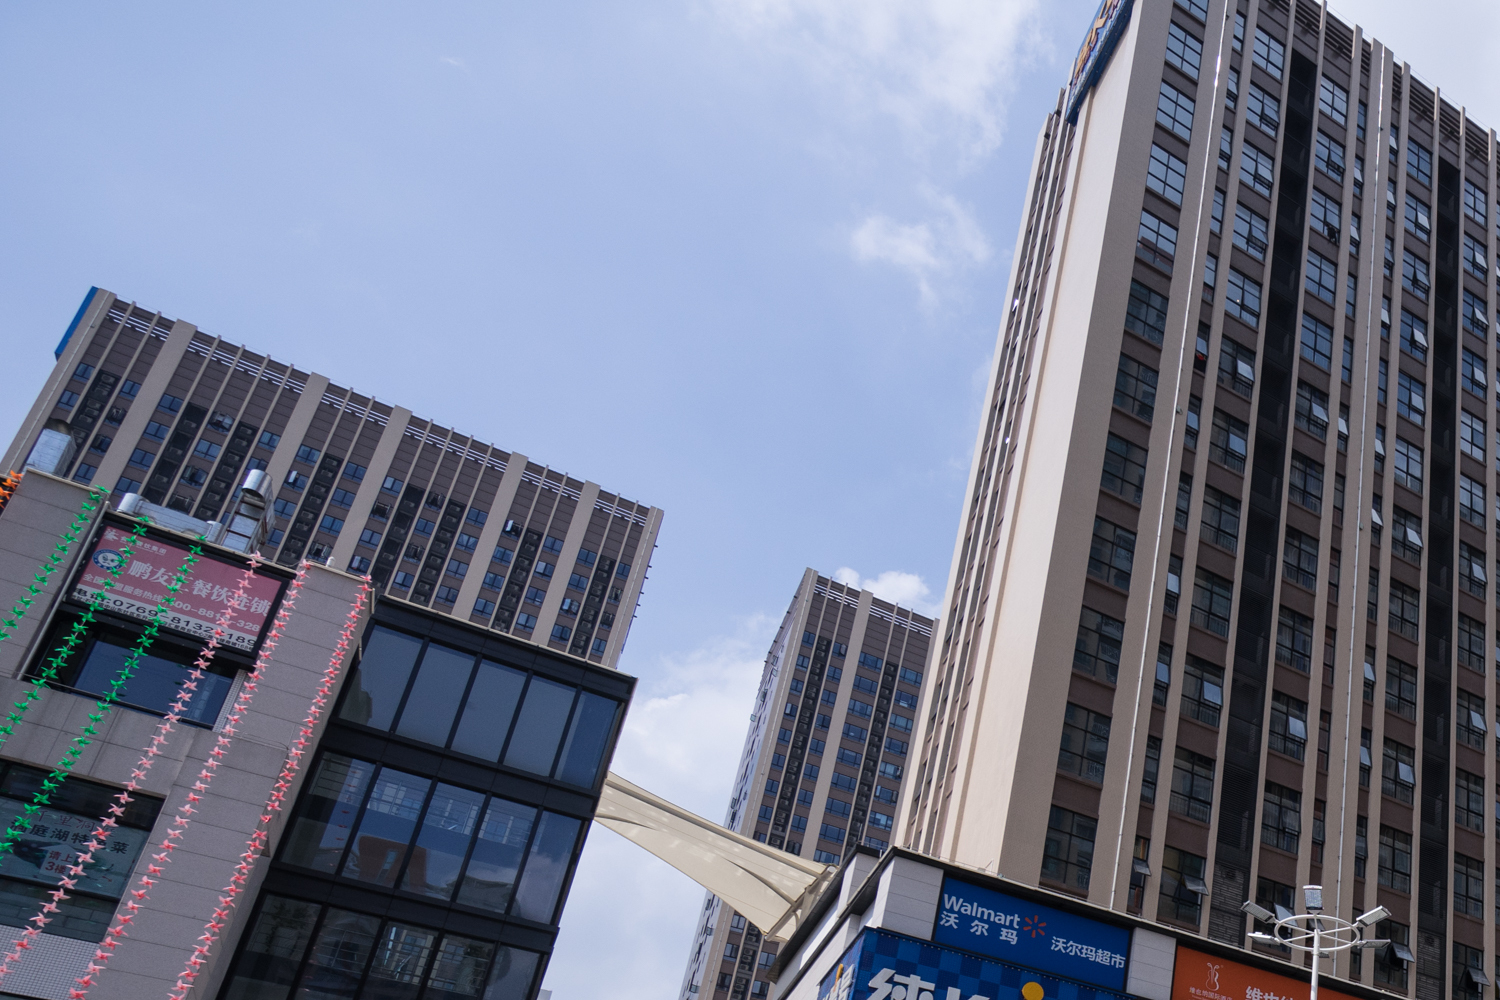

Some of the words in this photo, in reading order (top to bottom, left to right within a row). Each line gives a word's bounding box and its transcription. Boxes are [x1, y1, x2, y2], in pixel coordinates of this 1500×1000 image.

[944, 894, 1020, 929] Walmart
[940, 911, 1018, 945] 沃尔玛
[1051, 936, 1126, 969] 沃尔玛超市
